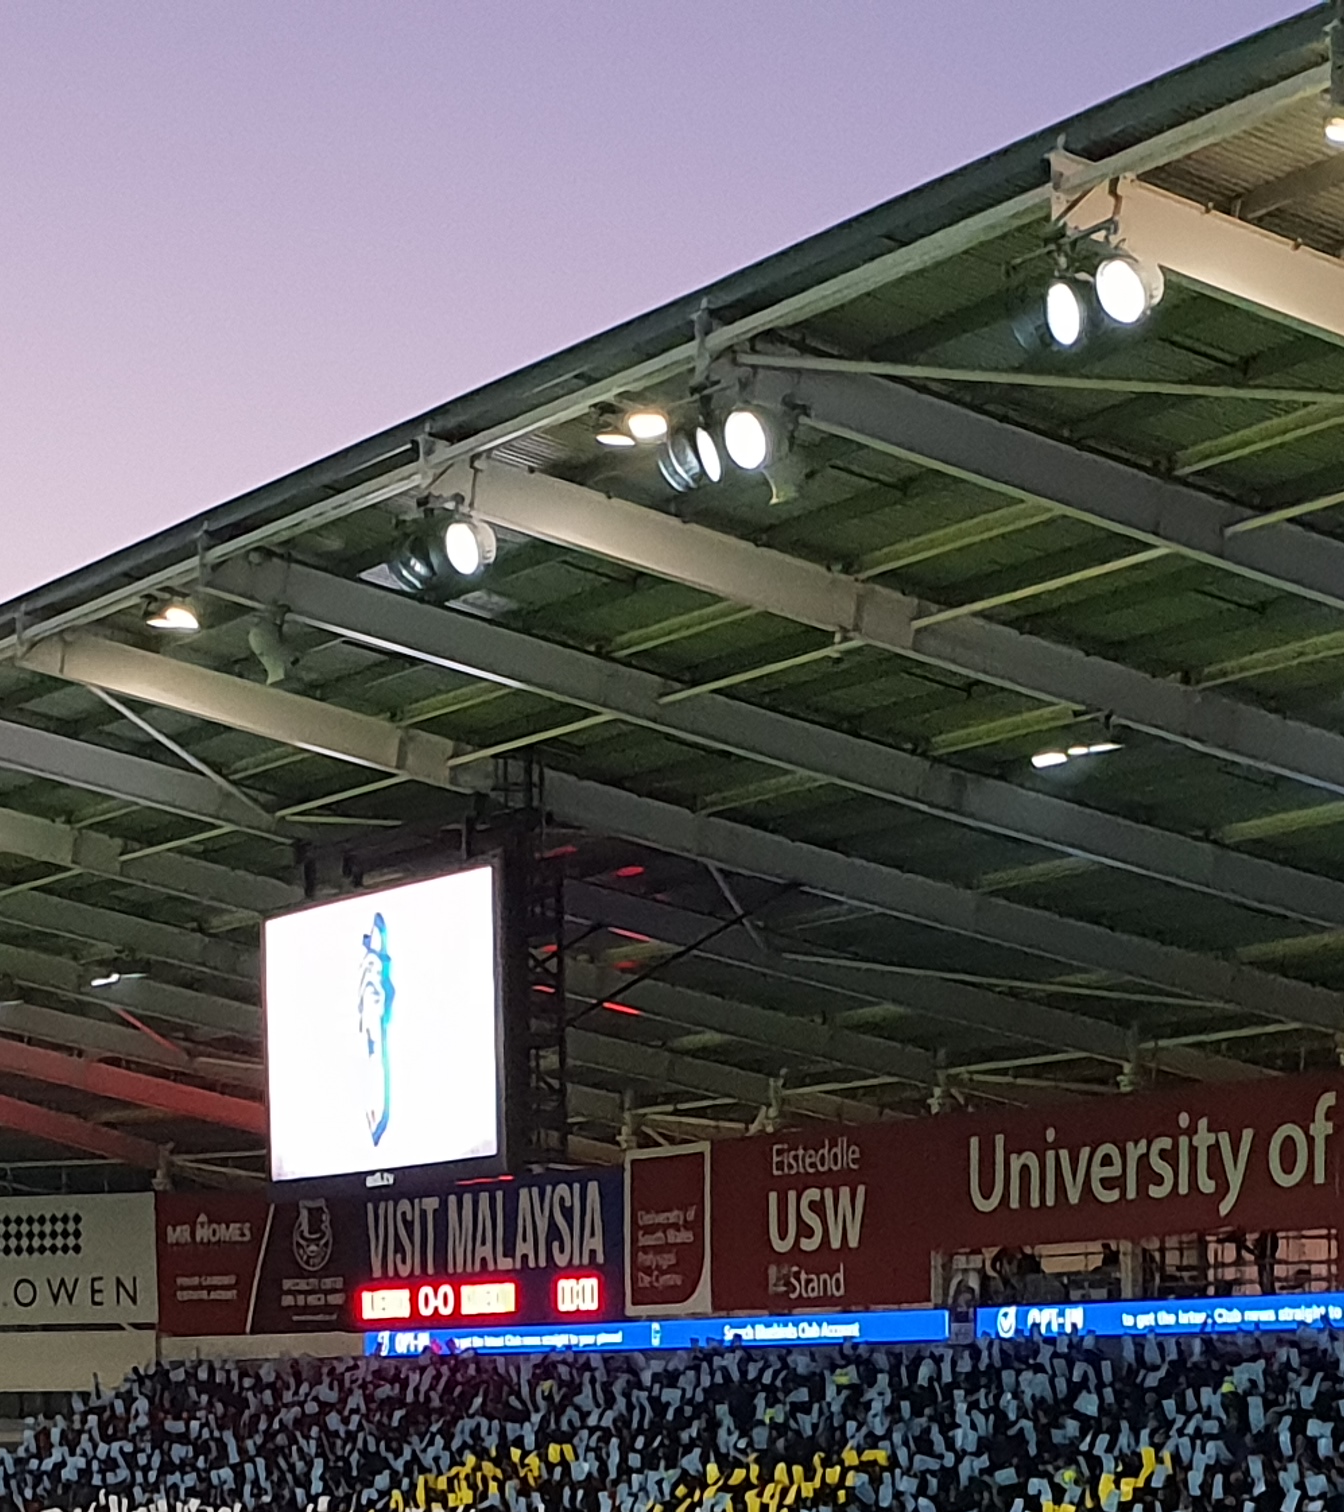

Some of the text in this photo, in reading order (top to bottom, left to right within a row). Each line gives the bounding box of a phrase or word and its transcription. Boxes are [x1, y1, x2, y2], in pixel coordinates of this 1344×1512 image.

[772, 1137, 860, 1176] Eisteddle
[969, 1111, 1254, 1218] University
[1268, 1091, 1337, 1188] of
[367, 1181, 605, 1278] VISIT MALAYSIA
[768, 1184, 866, 1253] USW
[789, 1262, 845, 1299] Stand
